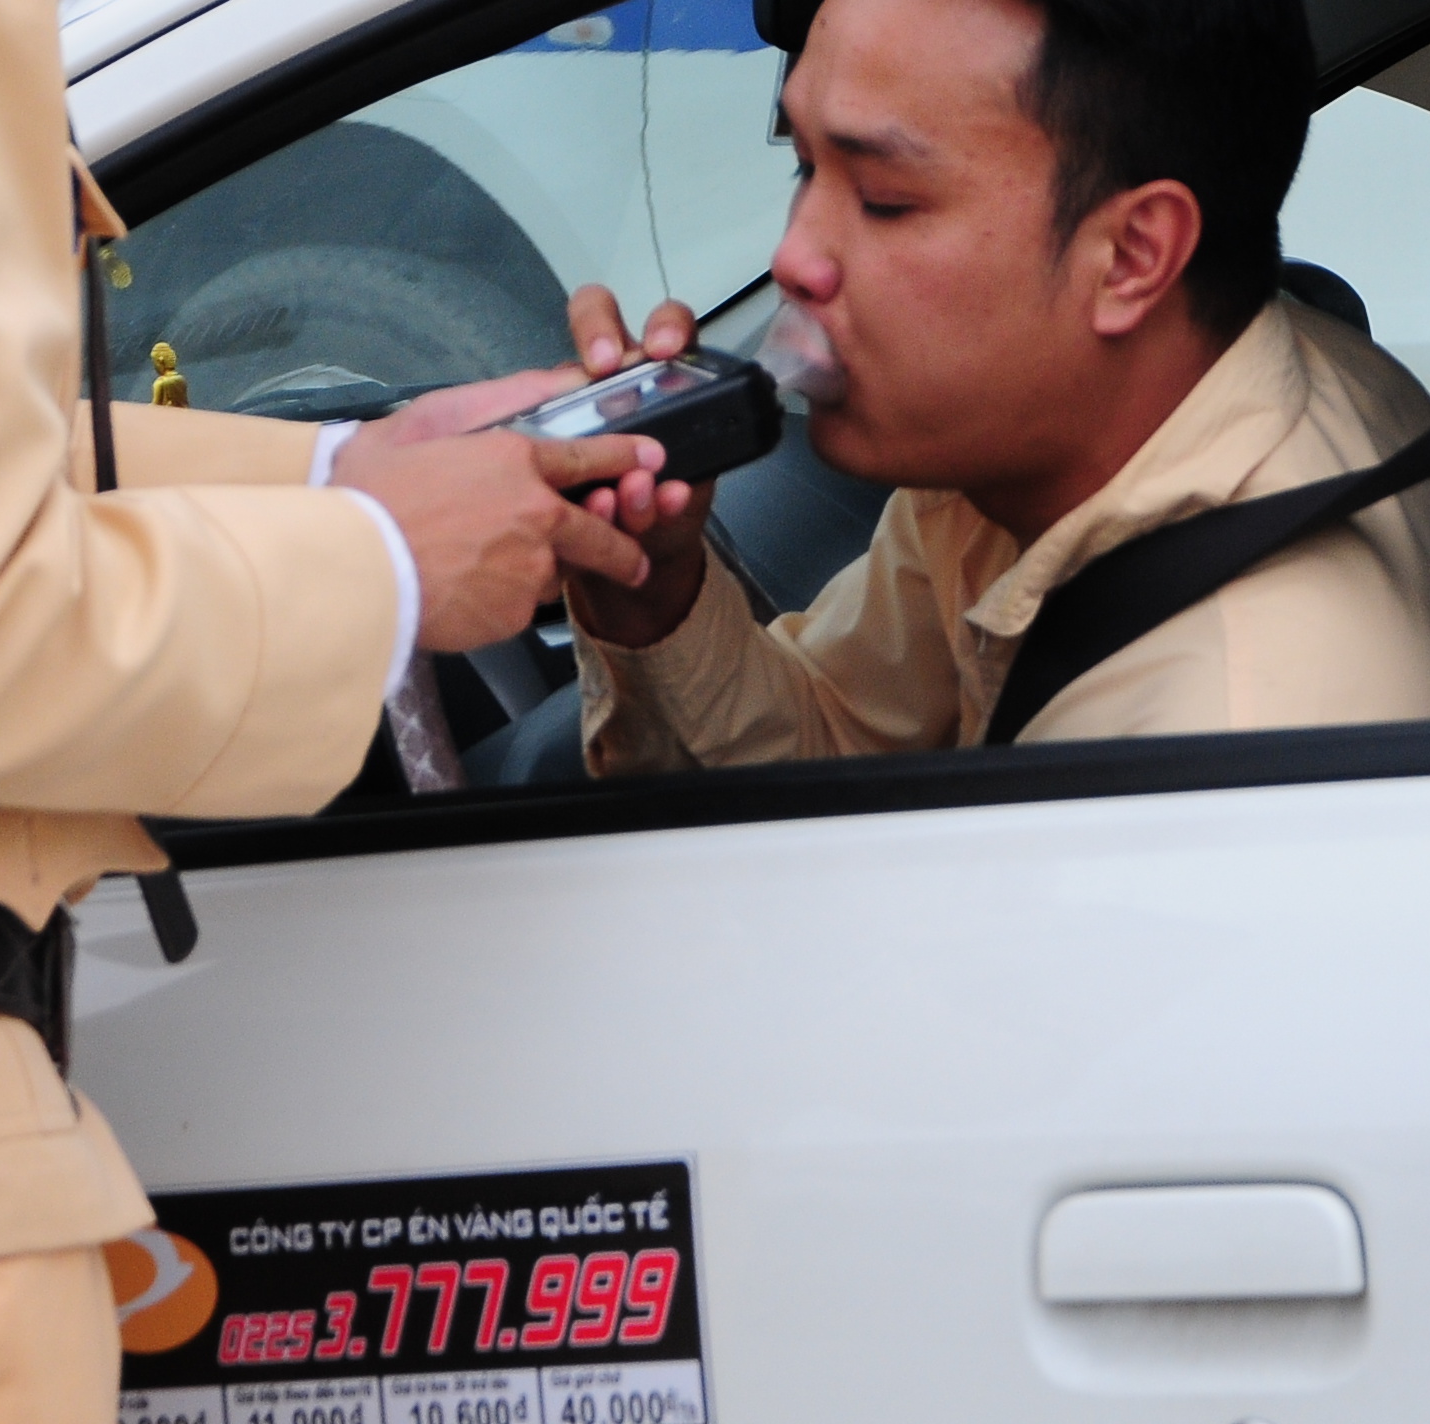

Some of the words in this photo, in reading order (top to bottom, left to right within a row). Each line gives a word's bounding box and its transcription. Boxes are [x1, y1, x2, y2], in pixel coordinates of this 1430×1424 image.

[229, 1217, 313, 1256] CÔNG
[318, 1219, 355, 1249] TY
[361, 1216, 403, 1248] CP
[408, 1206, 450, 1246] ÉN
[452, 1202, 533, 1243] VÀNG
[539, 1192, 625, 1242] QUỐC
[628, 1187, 670, 1232] TẾ
[410, 1391, 528, 1424] 10600đ
